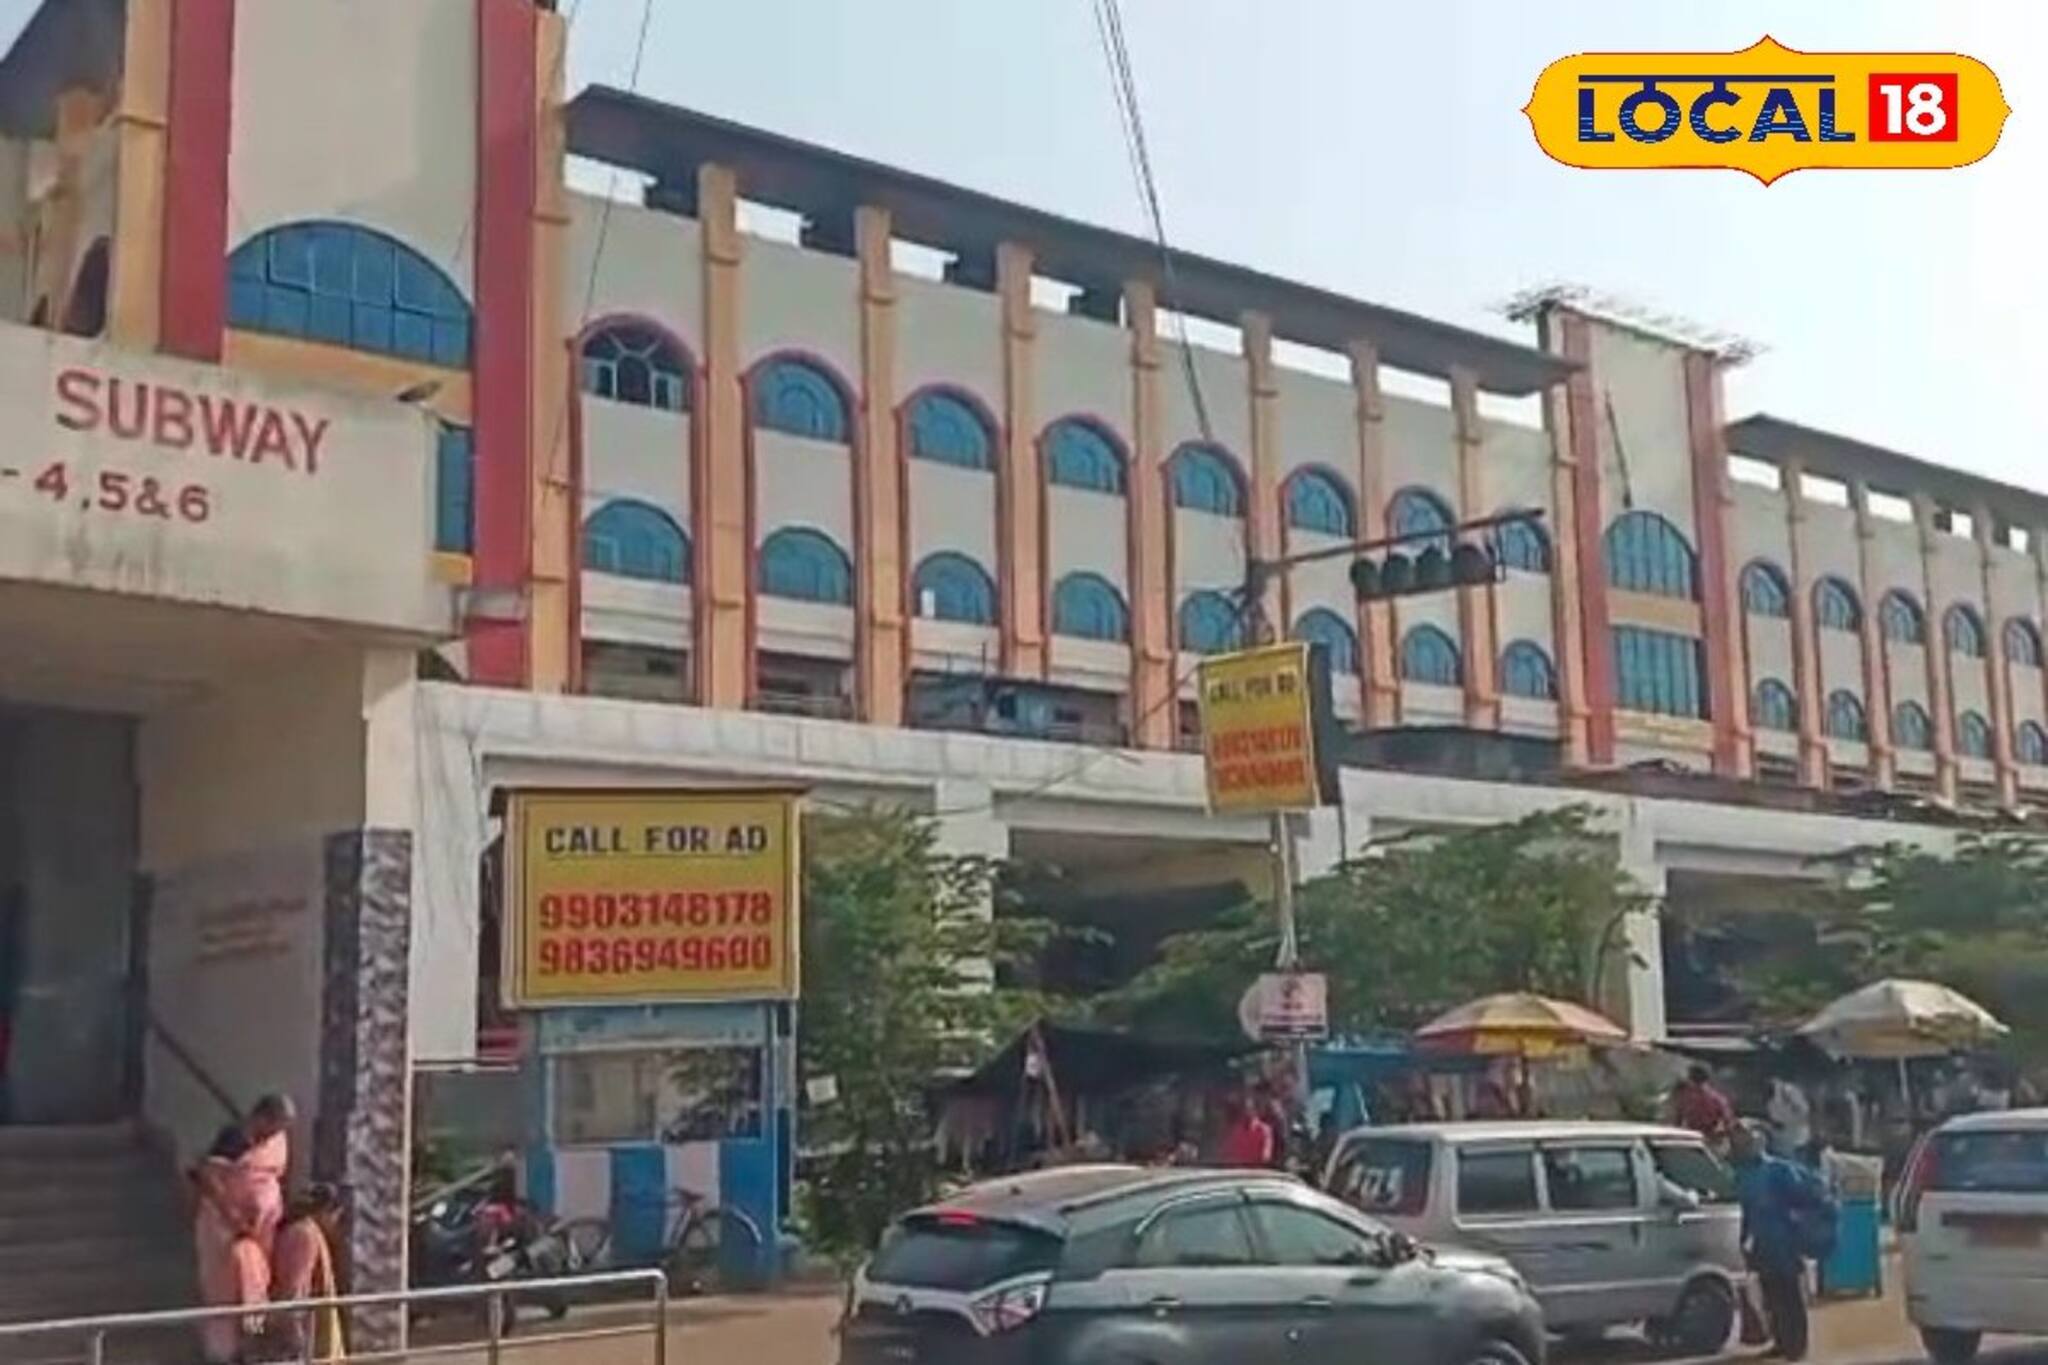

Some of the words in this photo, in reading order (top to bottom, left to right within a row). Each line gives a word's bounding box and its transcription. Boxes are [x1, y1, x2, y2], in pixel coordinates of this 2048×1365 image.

[56, 369, 331, 475] SUBWAY
[545, 826, 629, 853] CALL
[646, 825, 711, 852] FOR
[725, 825, 769, 852] AD
